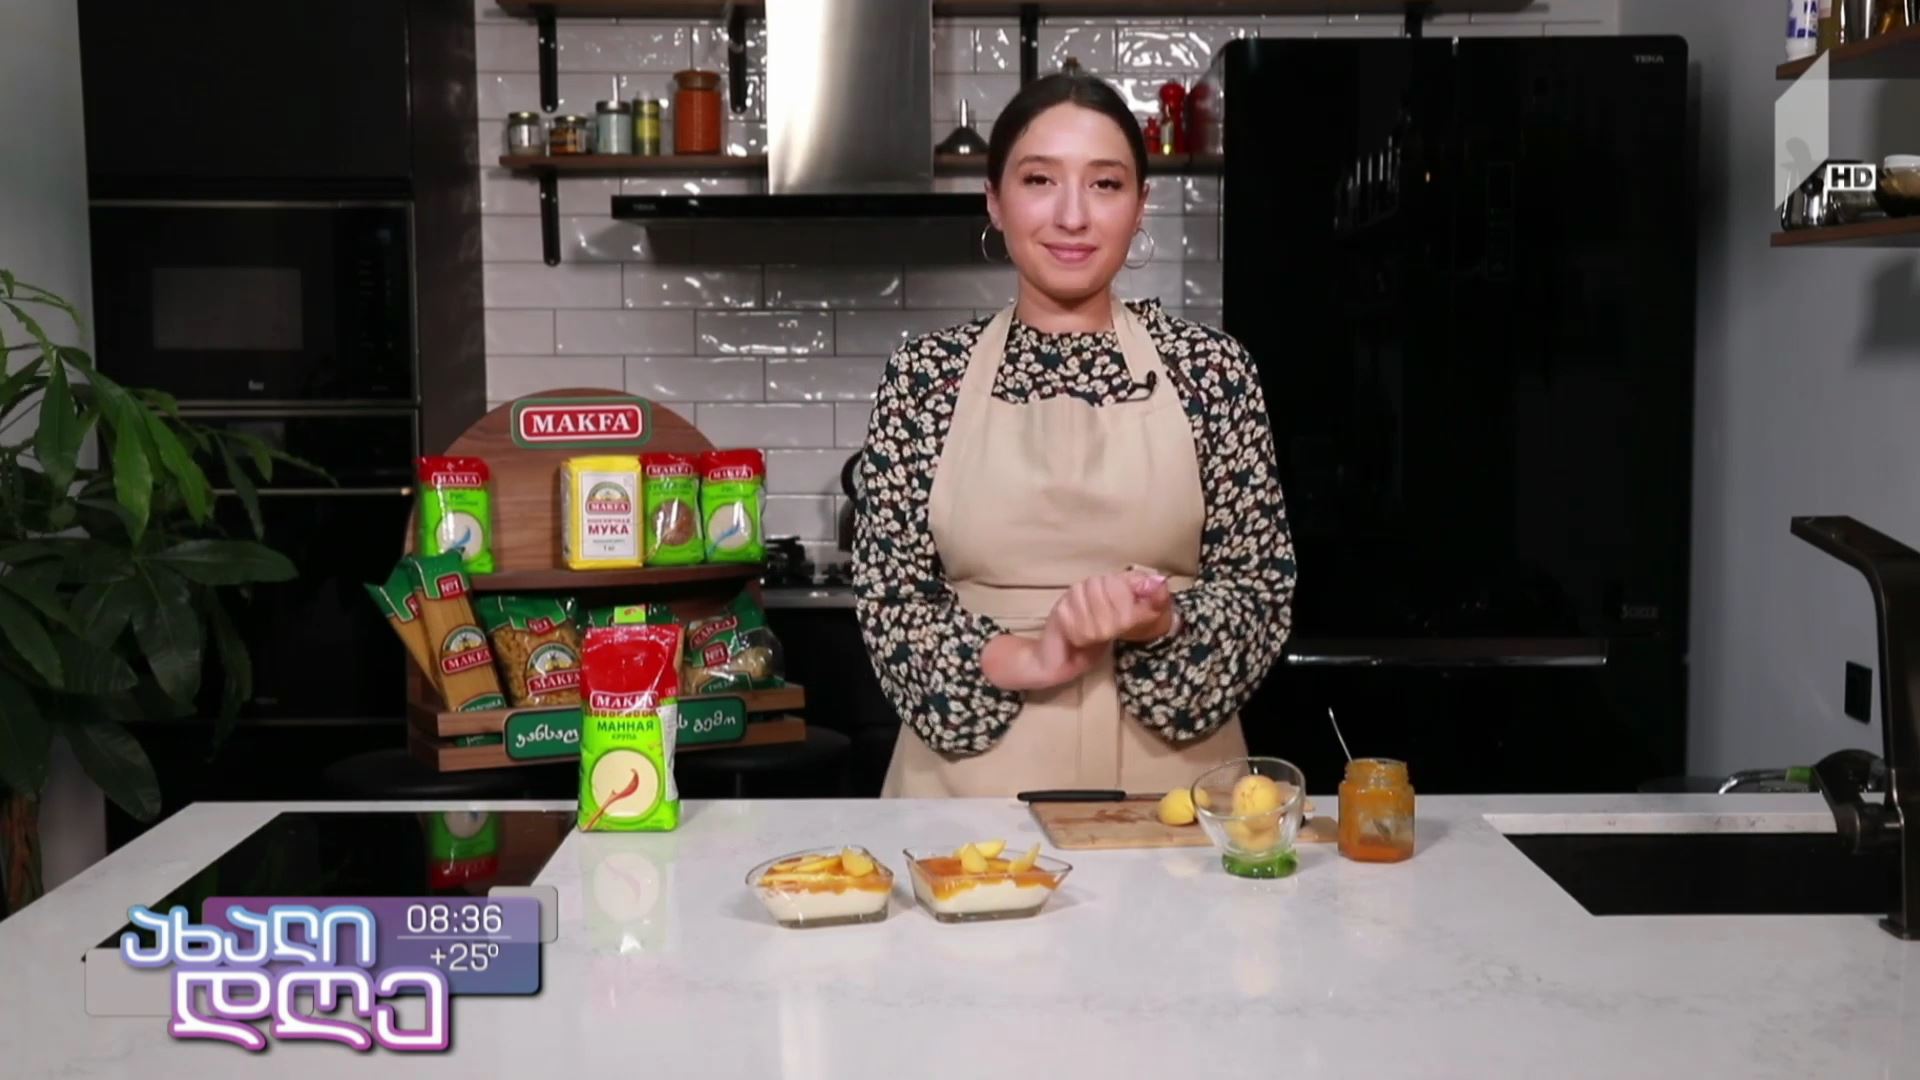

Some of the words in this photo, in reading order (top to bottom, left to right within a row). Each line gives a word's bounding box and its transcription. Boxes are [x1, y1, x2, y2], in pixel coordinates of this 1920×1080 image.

[531, 411, 632, 434] MAKFA
[436, 474, 478, 485] MAKFA
[591, 502, 628, 512] MAKFA
[588, 524, 629, 536] МУКА
[447, 649, 491, 669] MAKFA
[596, 694, 655, 708] MAKFA
[597, 720, 655, 732] МАННАЯ
[611, 733, 638, 741] КРУПА
